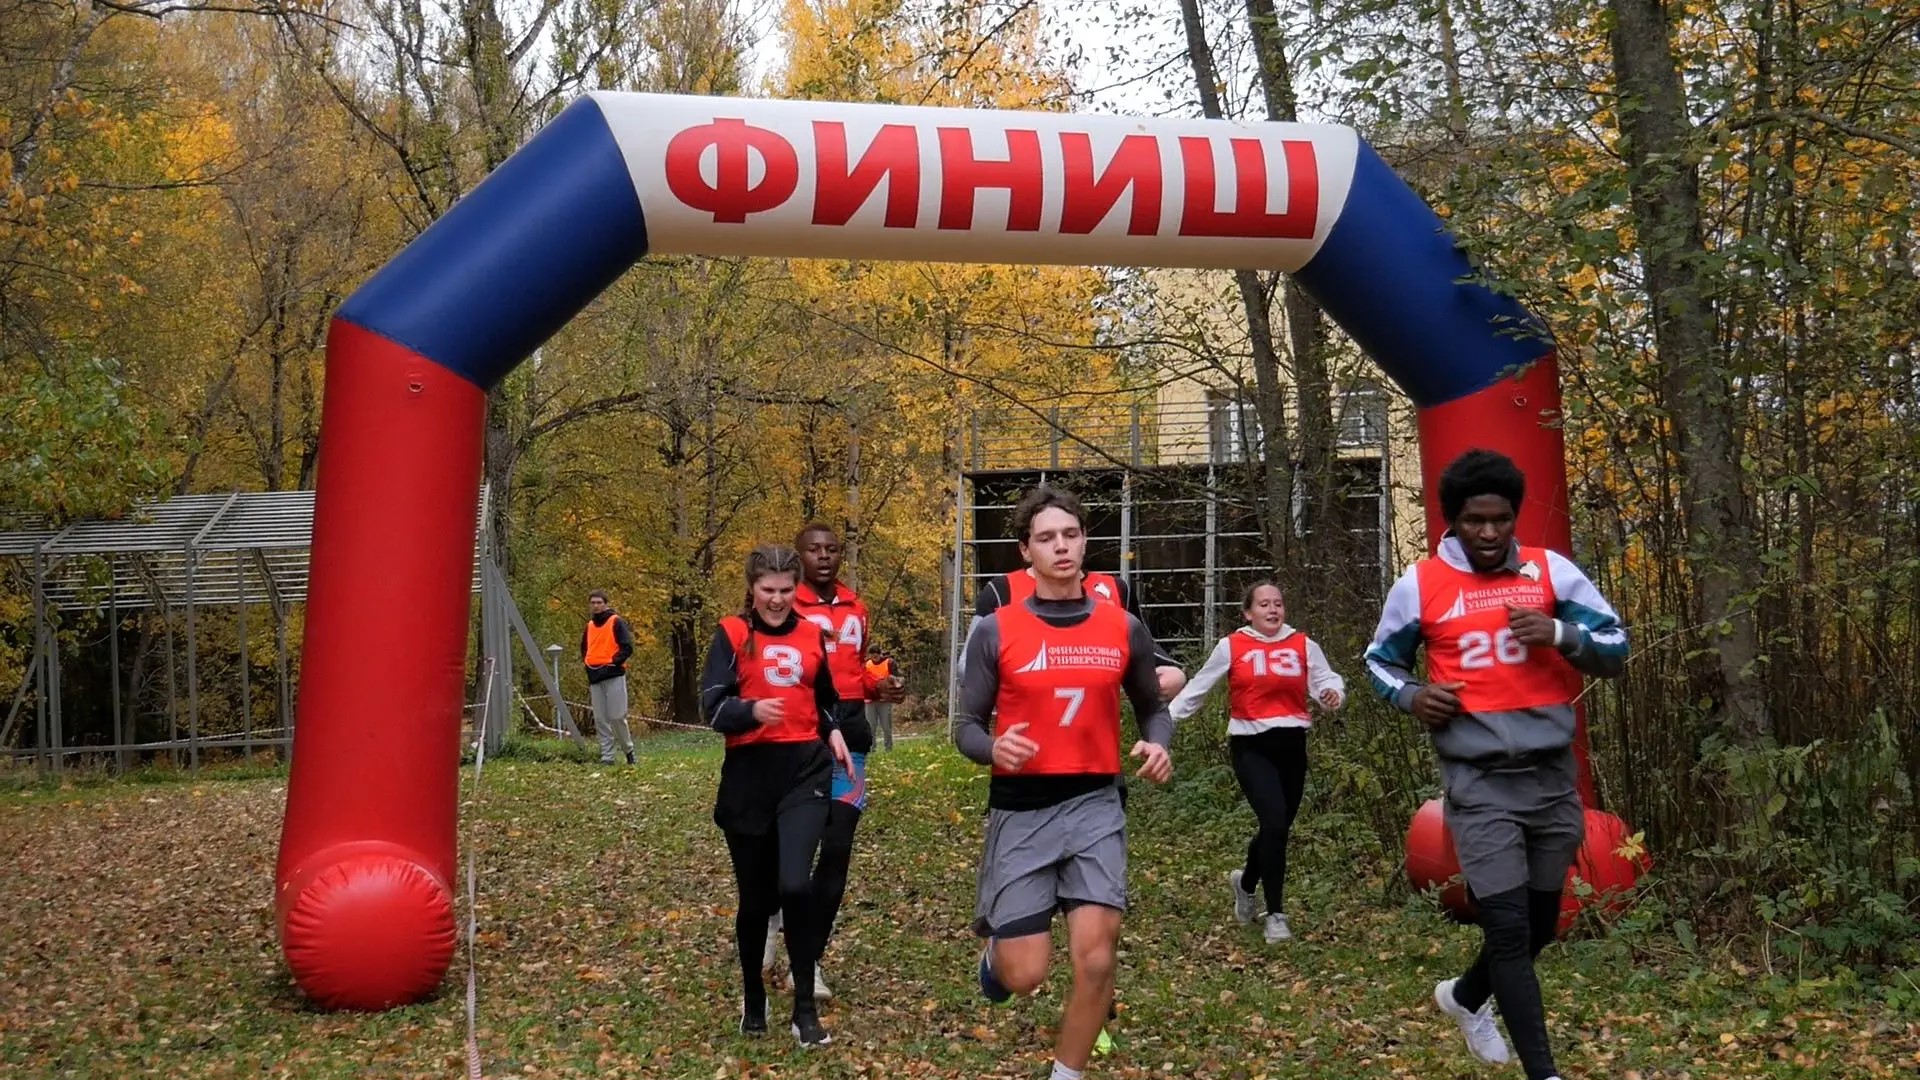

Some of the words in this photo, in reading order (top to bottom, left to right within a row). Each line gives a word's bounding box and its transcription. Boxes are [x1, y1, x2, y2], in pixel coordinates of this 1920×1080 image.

[665, 117, 1320, 240] ФИНИШ
[762, 644, 803, 688] 3
[1047, 645, 1121, 658] ФИНАНСОВЫЙ
[1048, 655, 1121, 668] УНИВЕРСИТЕТ
[1240, 648, 1302, 677] 13
[1457, 626, 1529, 670] 26
[1054, 687, 1086, 727] 7
